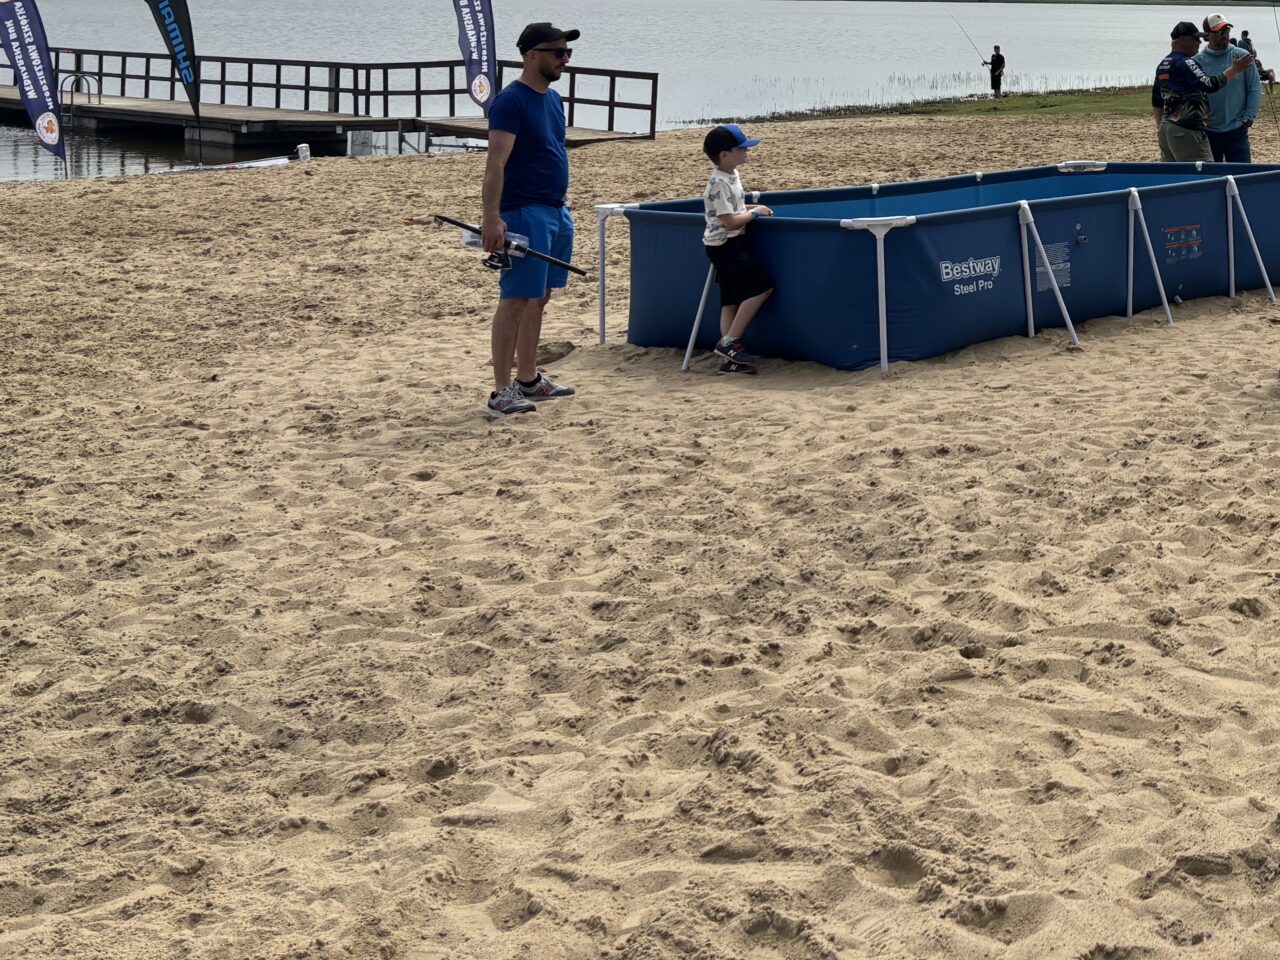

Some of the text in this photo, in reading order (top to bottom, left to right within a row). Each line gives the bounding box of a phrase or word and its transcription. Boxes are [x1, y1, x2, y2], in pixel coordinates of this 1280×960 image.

[940, 256, 1000, 281] Bestway
[954, 280, 993, 295] Steel Pro
